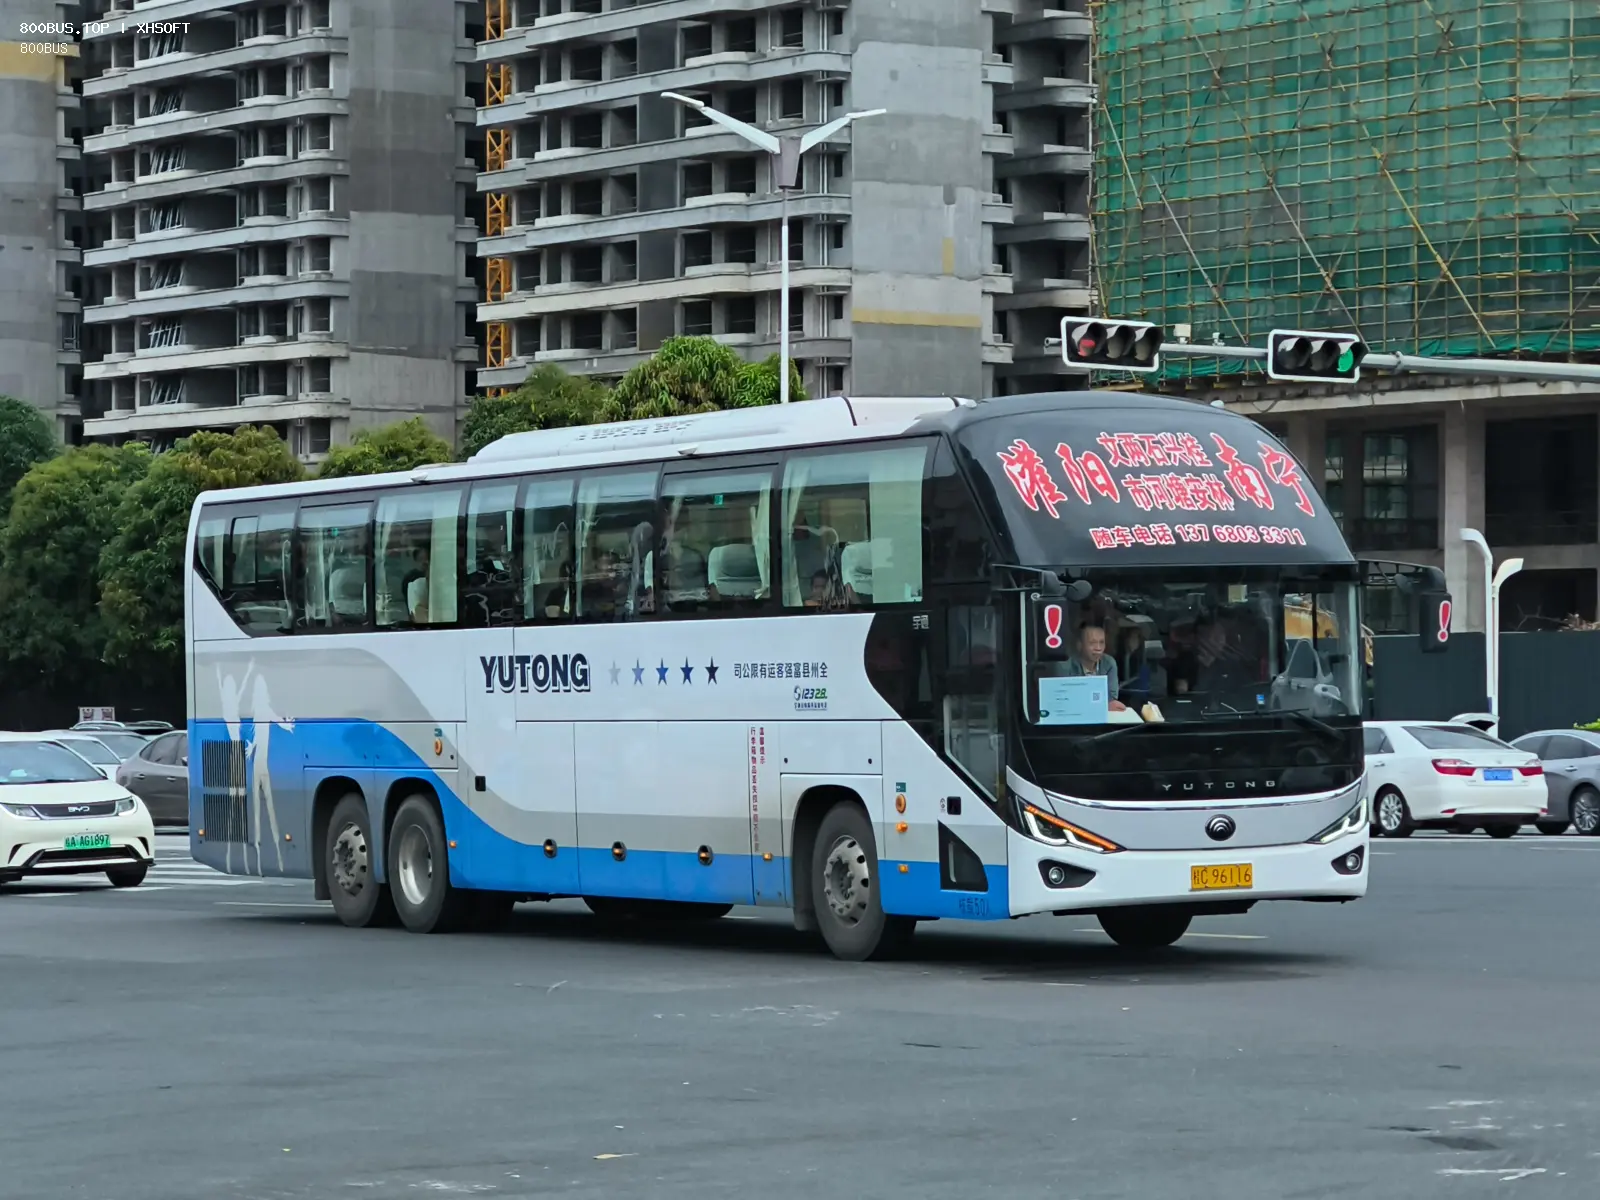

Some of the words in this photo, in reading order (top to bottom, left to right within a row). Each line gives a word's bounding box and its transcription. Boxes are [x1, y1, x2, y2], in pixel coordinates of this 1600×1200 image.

[1090, 523, 1176, 549] 随车电话
[1175, 524, 1209, 541] 137
[1213, 526, 1260, 543] 6803
[1259, 526, 1306, 545] 3311
[480, 653, 591, 693] YUTONG
[1162, 780, 1276, 791] YUTONG
